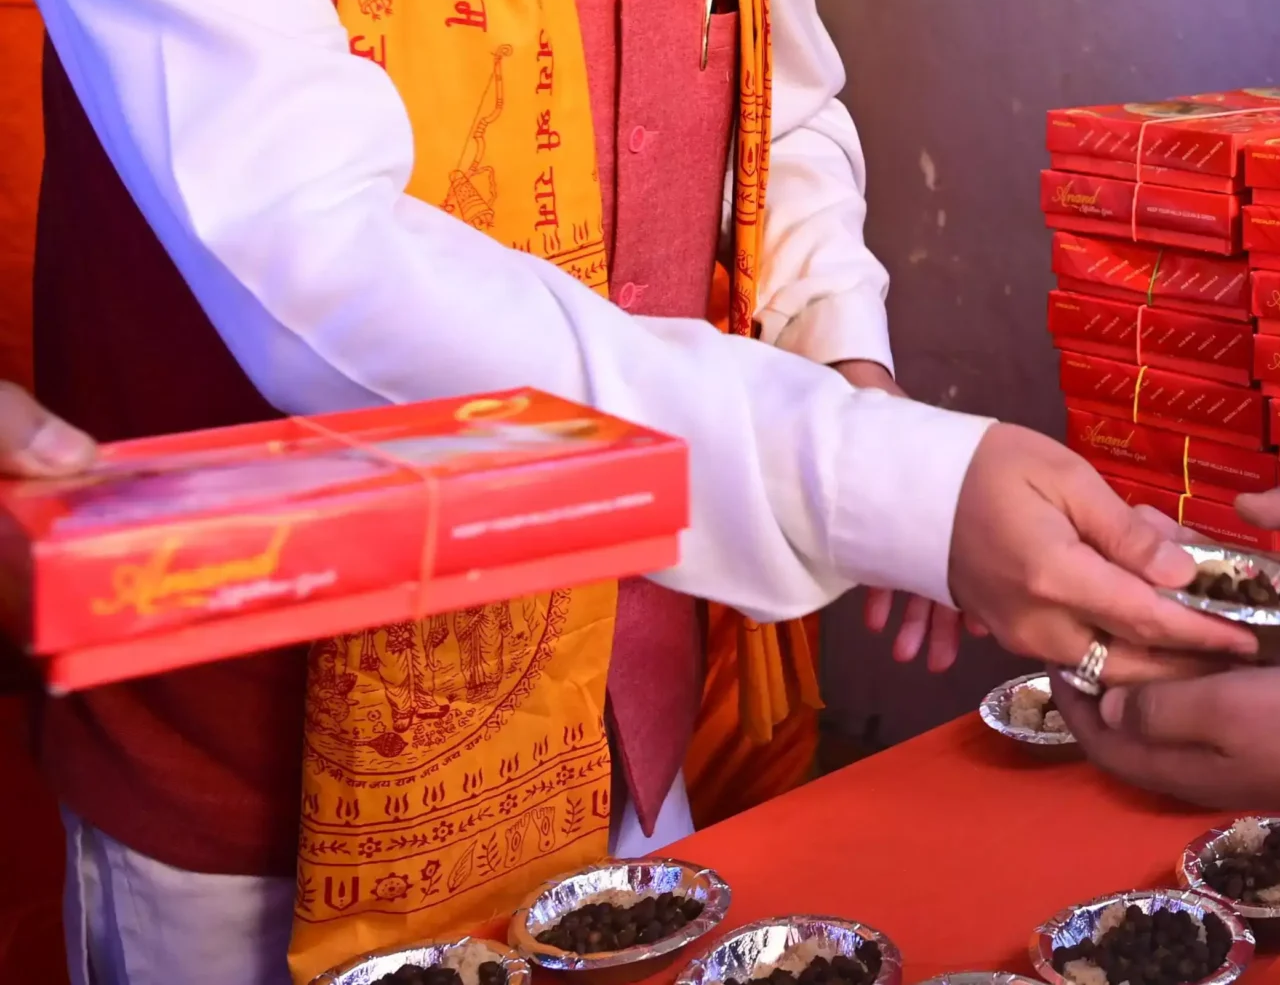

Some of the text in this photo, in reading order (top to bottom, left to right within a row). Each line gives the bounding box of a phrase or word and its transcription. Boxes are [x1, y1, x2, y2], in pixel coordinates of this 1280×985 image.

[535, 108, 562, 155] श्री
[534, 166, 560, 231] राम
[1052, 180, 1101, 209] Anand
[1080, 420, 1135, 450] Anand
[369, 780, 391, 789] जय
[395, 775, 416, 786] राम
[442, 751, 461, 766] जय
[464, 734, 483, 751] राम
